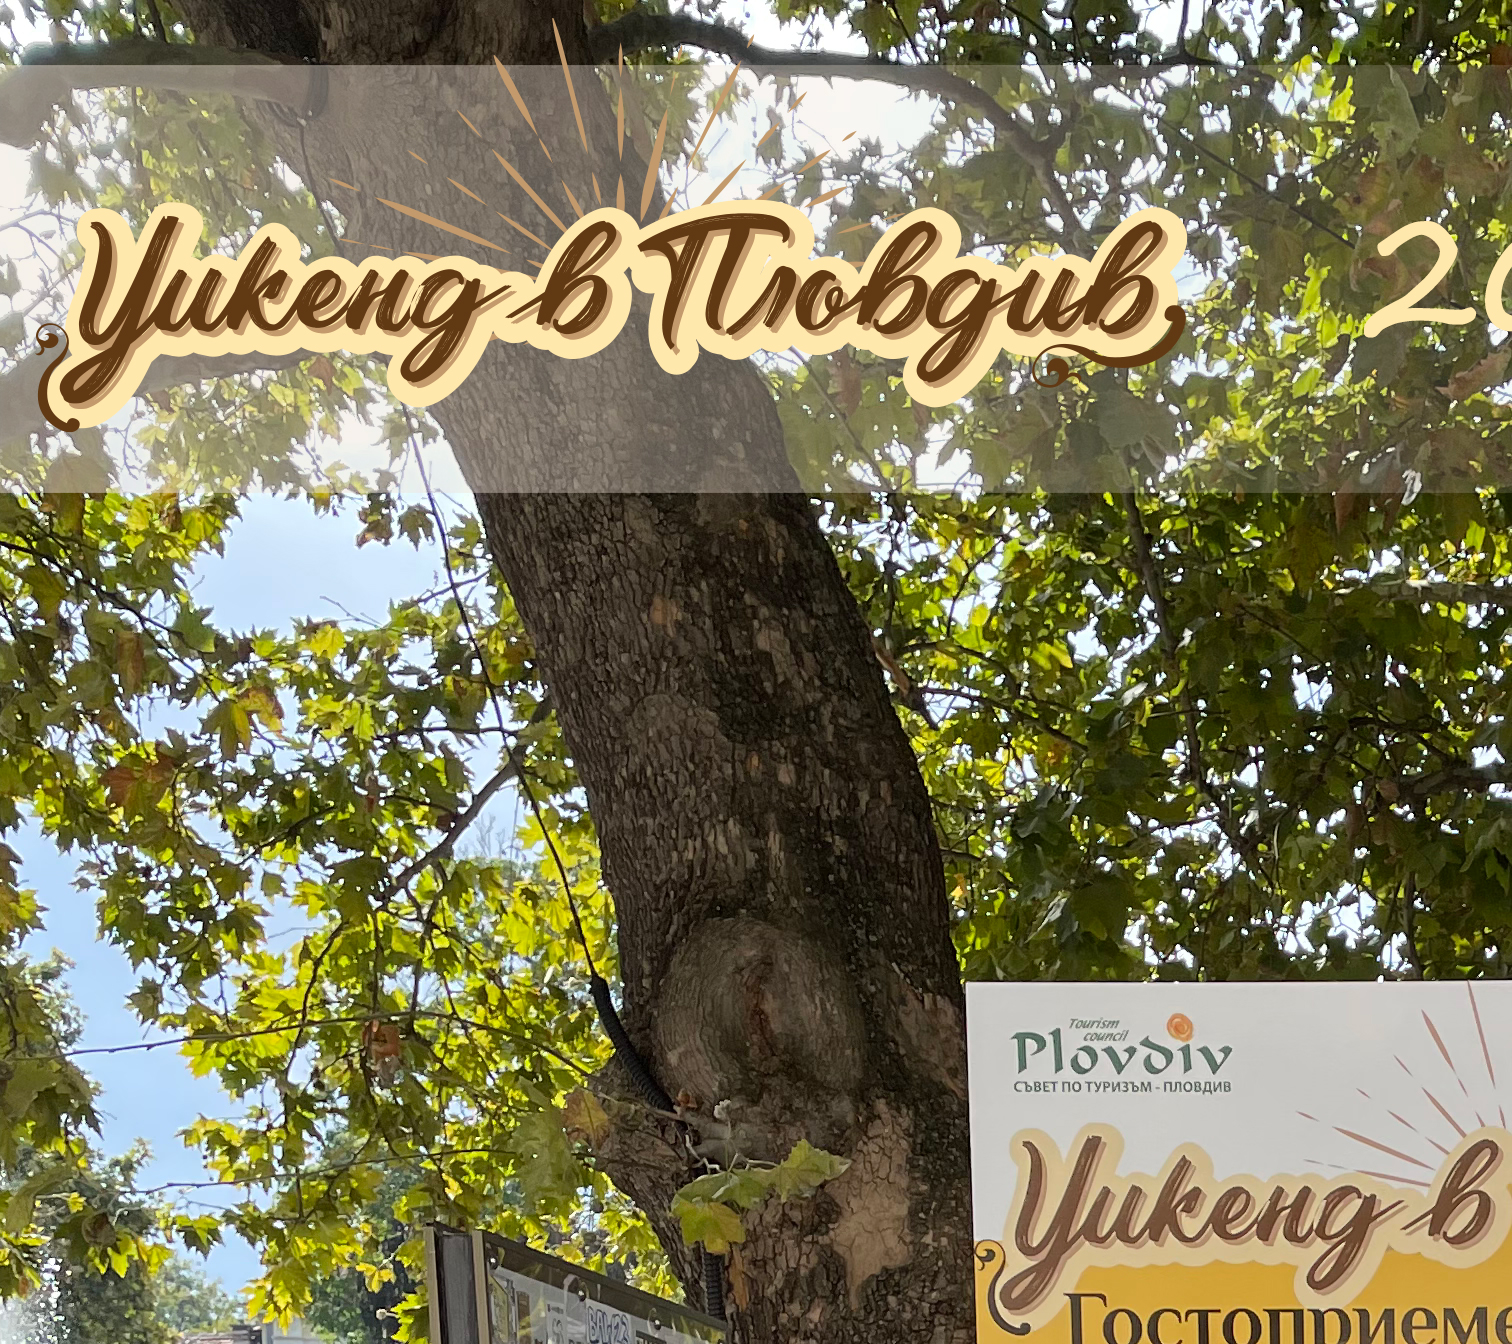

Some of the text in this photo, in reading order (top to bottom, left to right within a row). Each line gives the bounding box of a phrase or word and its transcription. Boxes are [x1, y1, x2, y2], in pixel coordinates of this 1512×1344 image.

[1068, 1017, 1121, 1030] Tourism
[1083, 1030, 1130, 1043] council
[1009, 1026, 1234, 1076] Plovdiv
[1013, 1080, 1058, 1094] СЪВЕТ
[1061, 1080, 1083, 1094] ПО
[1085, 1080, 1153, 1094] ТУРИЗЪМ
[1163, 1080, 1233, 1095] ПЛОВДИВ
[999, 1134, 1404, 1312] Уикенд
[1401, 1138, 1504, 1248] в
